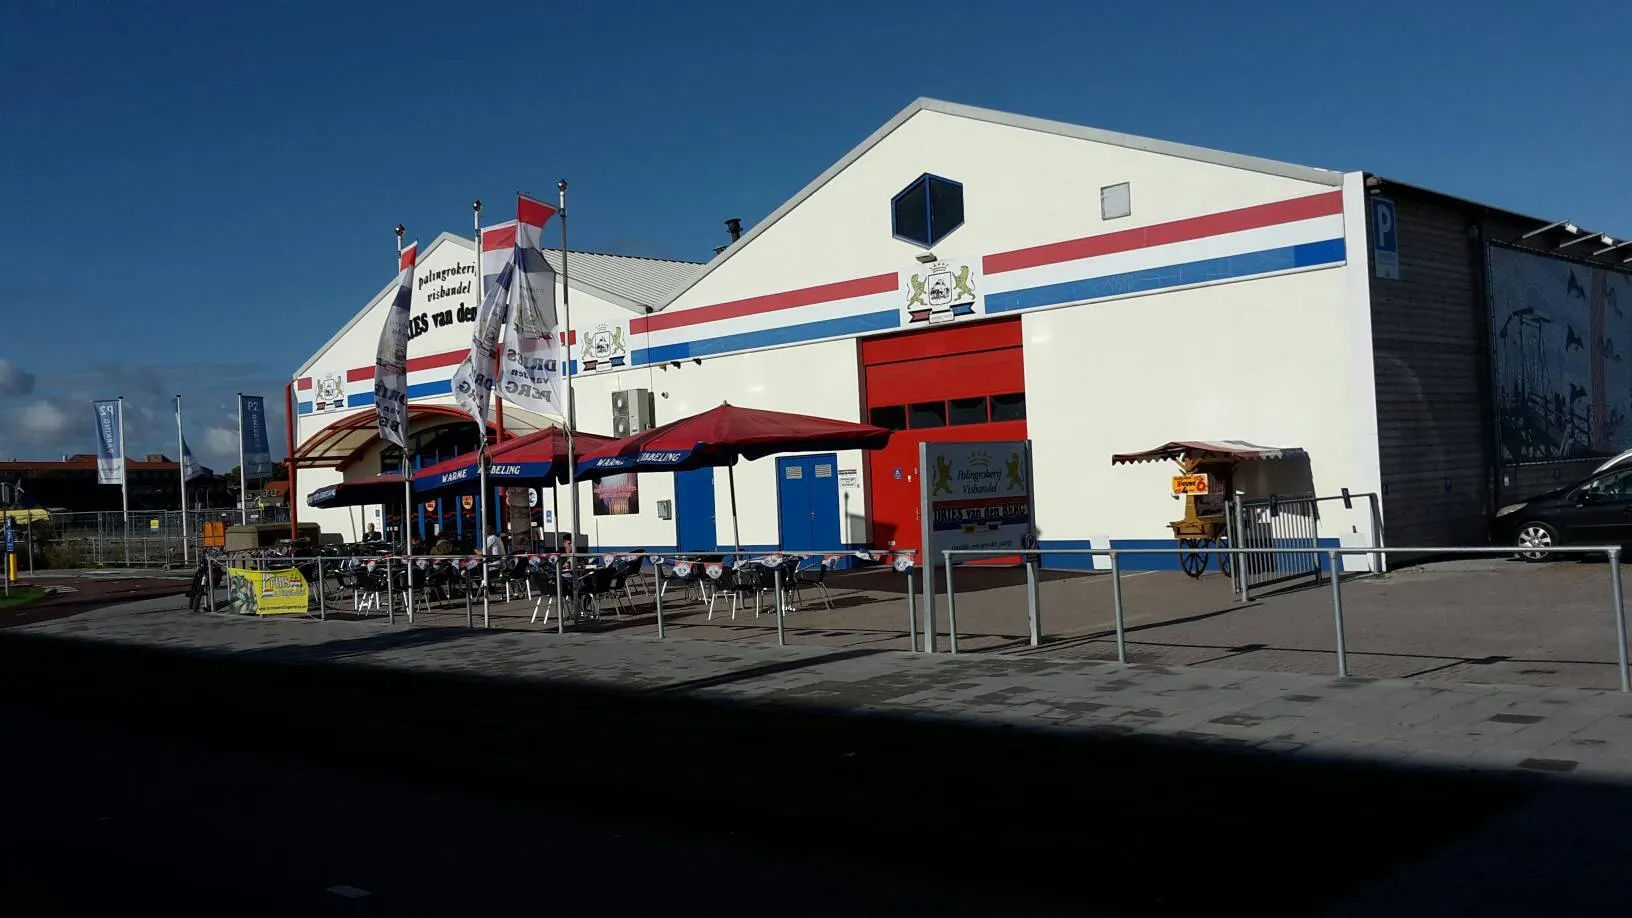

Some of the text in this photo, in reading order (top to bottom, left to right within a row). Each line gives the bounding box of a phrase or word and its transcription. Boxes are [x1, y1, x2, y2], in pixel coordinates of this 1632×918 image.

[1377, 204, 1391, 247] P
[431, 309, 453, 328] van
[442, 469, 468, 483] WARME
[935, 503, 1025, 522] DRIES van den BERG
